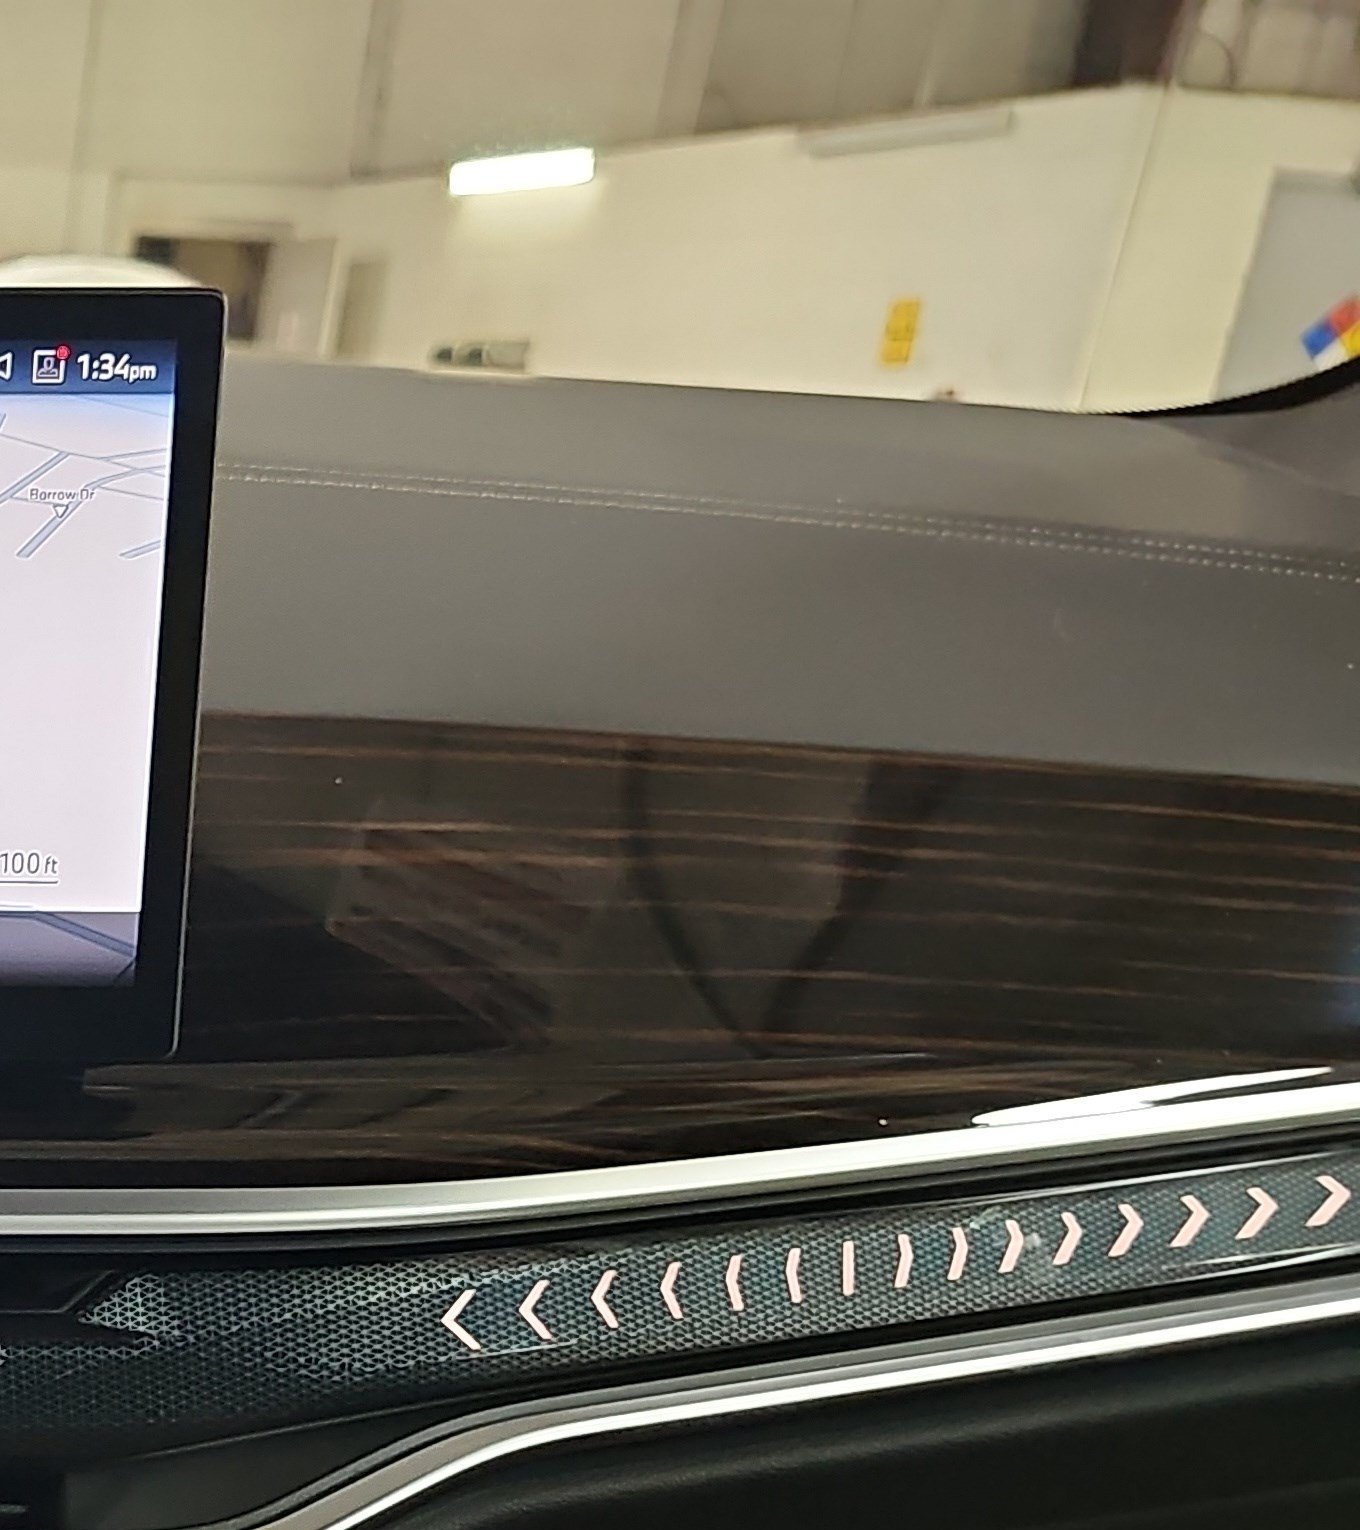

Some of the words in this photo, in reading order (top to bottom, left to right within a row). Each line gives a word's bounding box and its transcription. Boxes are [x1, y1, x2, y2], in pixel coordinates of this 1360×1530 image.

[77, 353, 157, 382] 1:34pm
[80, 489, 94, 499] Dr
[44, 854, 58, 875] ft
